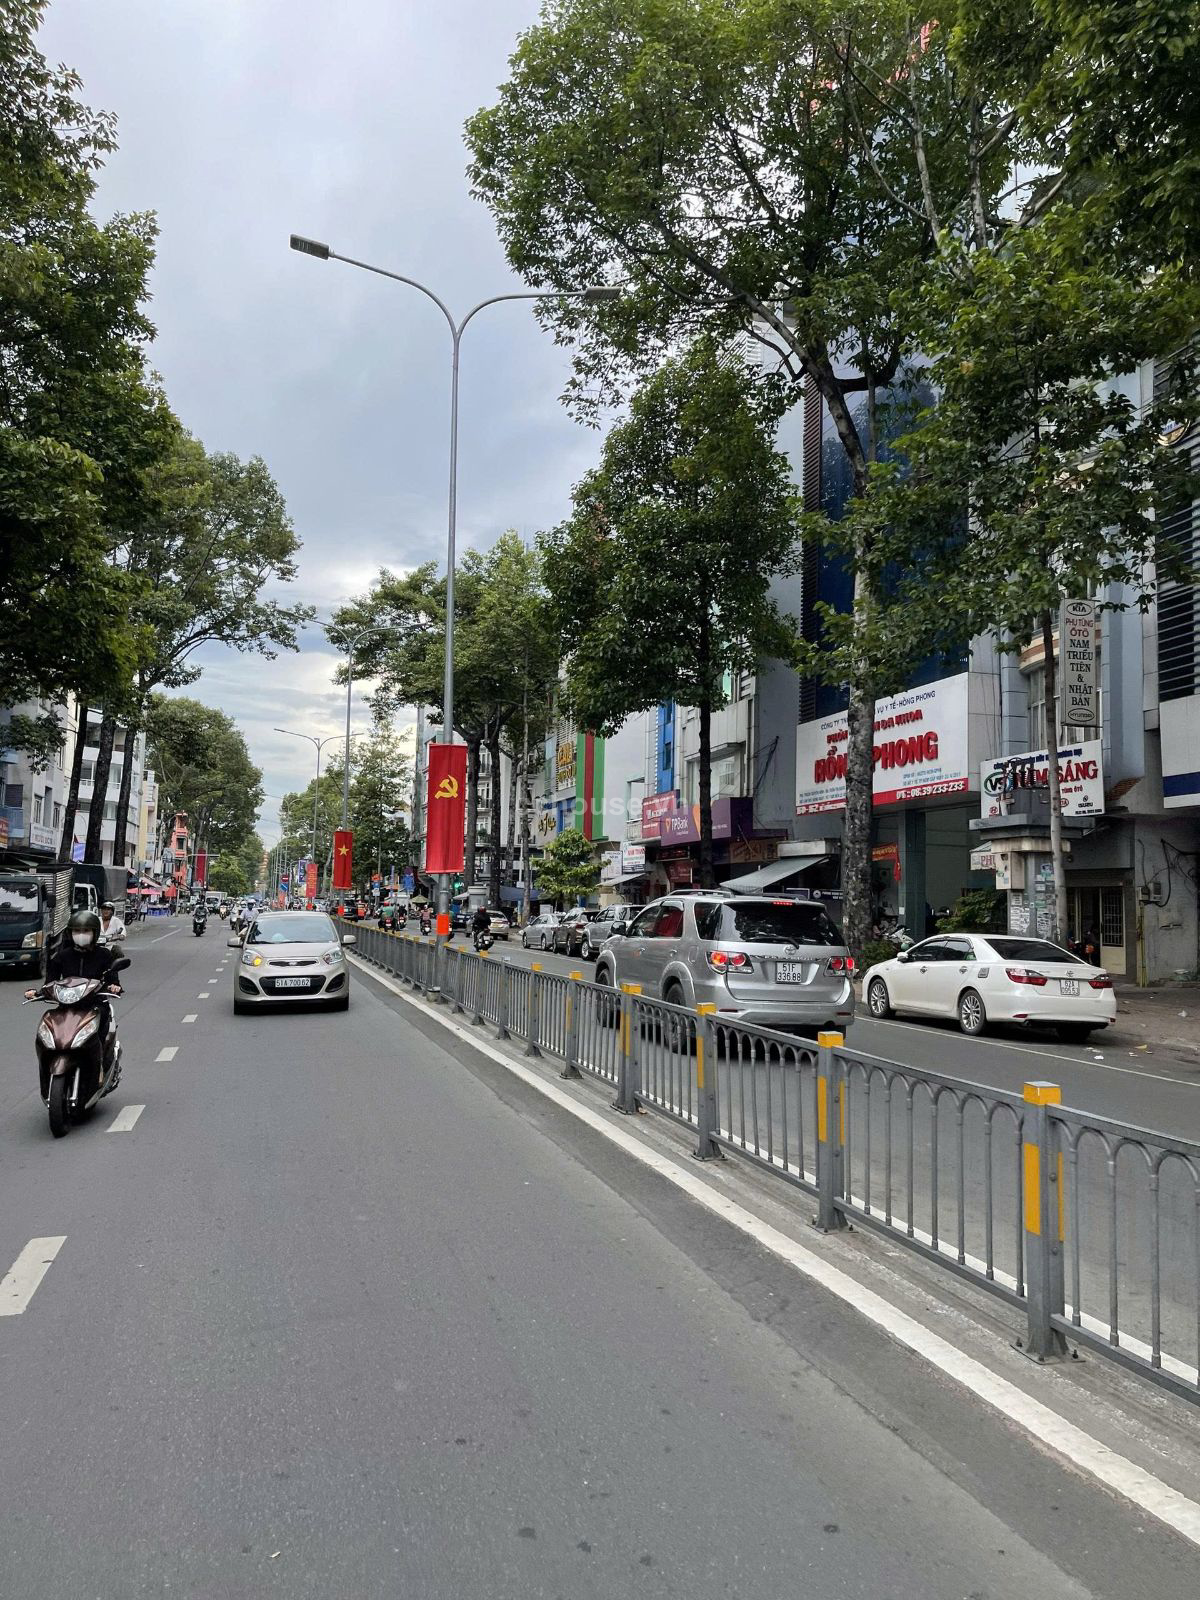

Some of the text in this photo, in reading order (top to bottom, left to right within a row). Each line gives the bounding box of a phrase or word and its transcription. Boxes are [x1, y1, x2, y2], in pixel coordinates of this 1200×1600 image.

[1072, 605, 1087, 613] KIA
[1069, 639, 1090, 649] NAM
[1070, 661, 1091, 673] TIÊN
[1077, 673, 1084, 683] &
[1069, 683, 1093, 696] NHẬT
[915, 690, 936, 702] PHONG
[872, 731, 938, 773] PHONG
[782, 963, 796, 973] 51F
[276, 979, 288, 987] 51A
